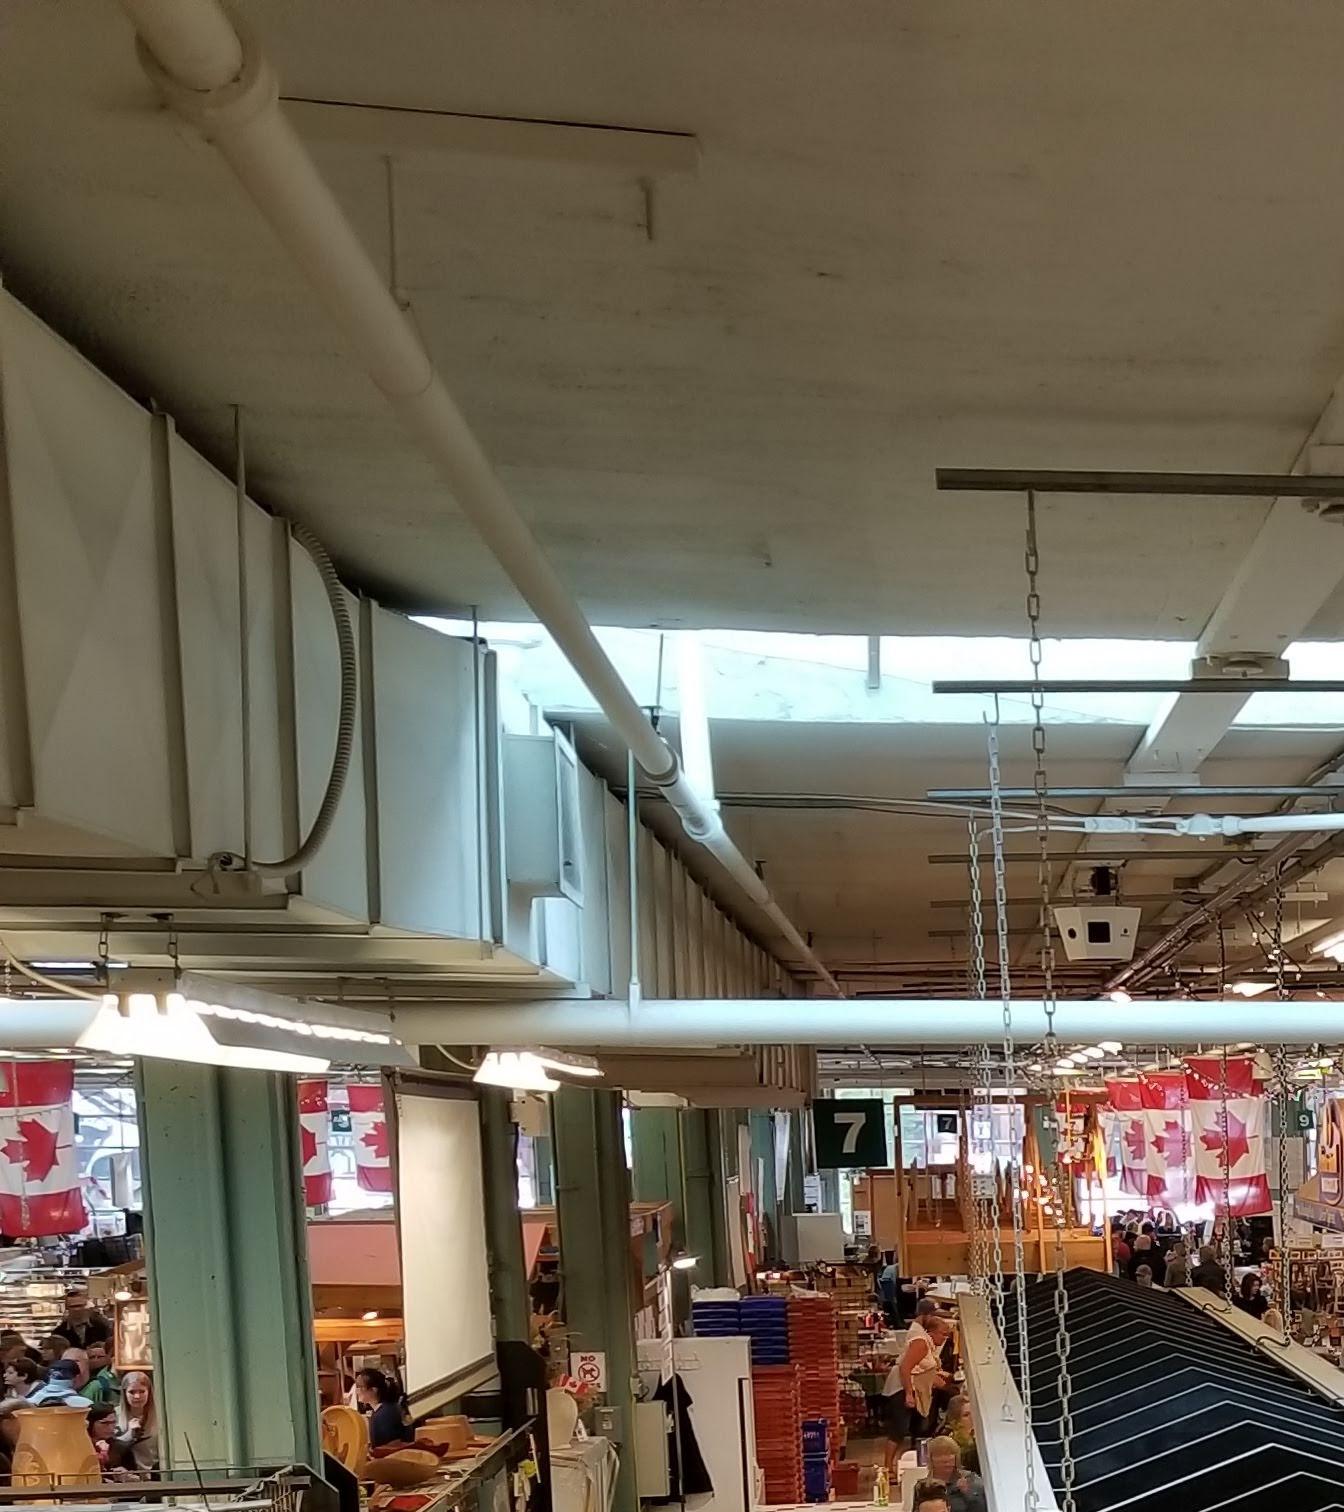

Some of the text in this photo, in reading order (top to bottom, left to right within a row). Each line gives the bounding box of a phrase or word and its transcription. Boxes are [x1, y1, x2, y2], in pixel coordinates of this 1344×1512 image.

[943, 1117, 953, 1130] 7
[1299, 1114, 1310, 1127] 9
[834, 1112, 866, 1153] 7
